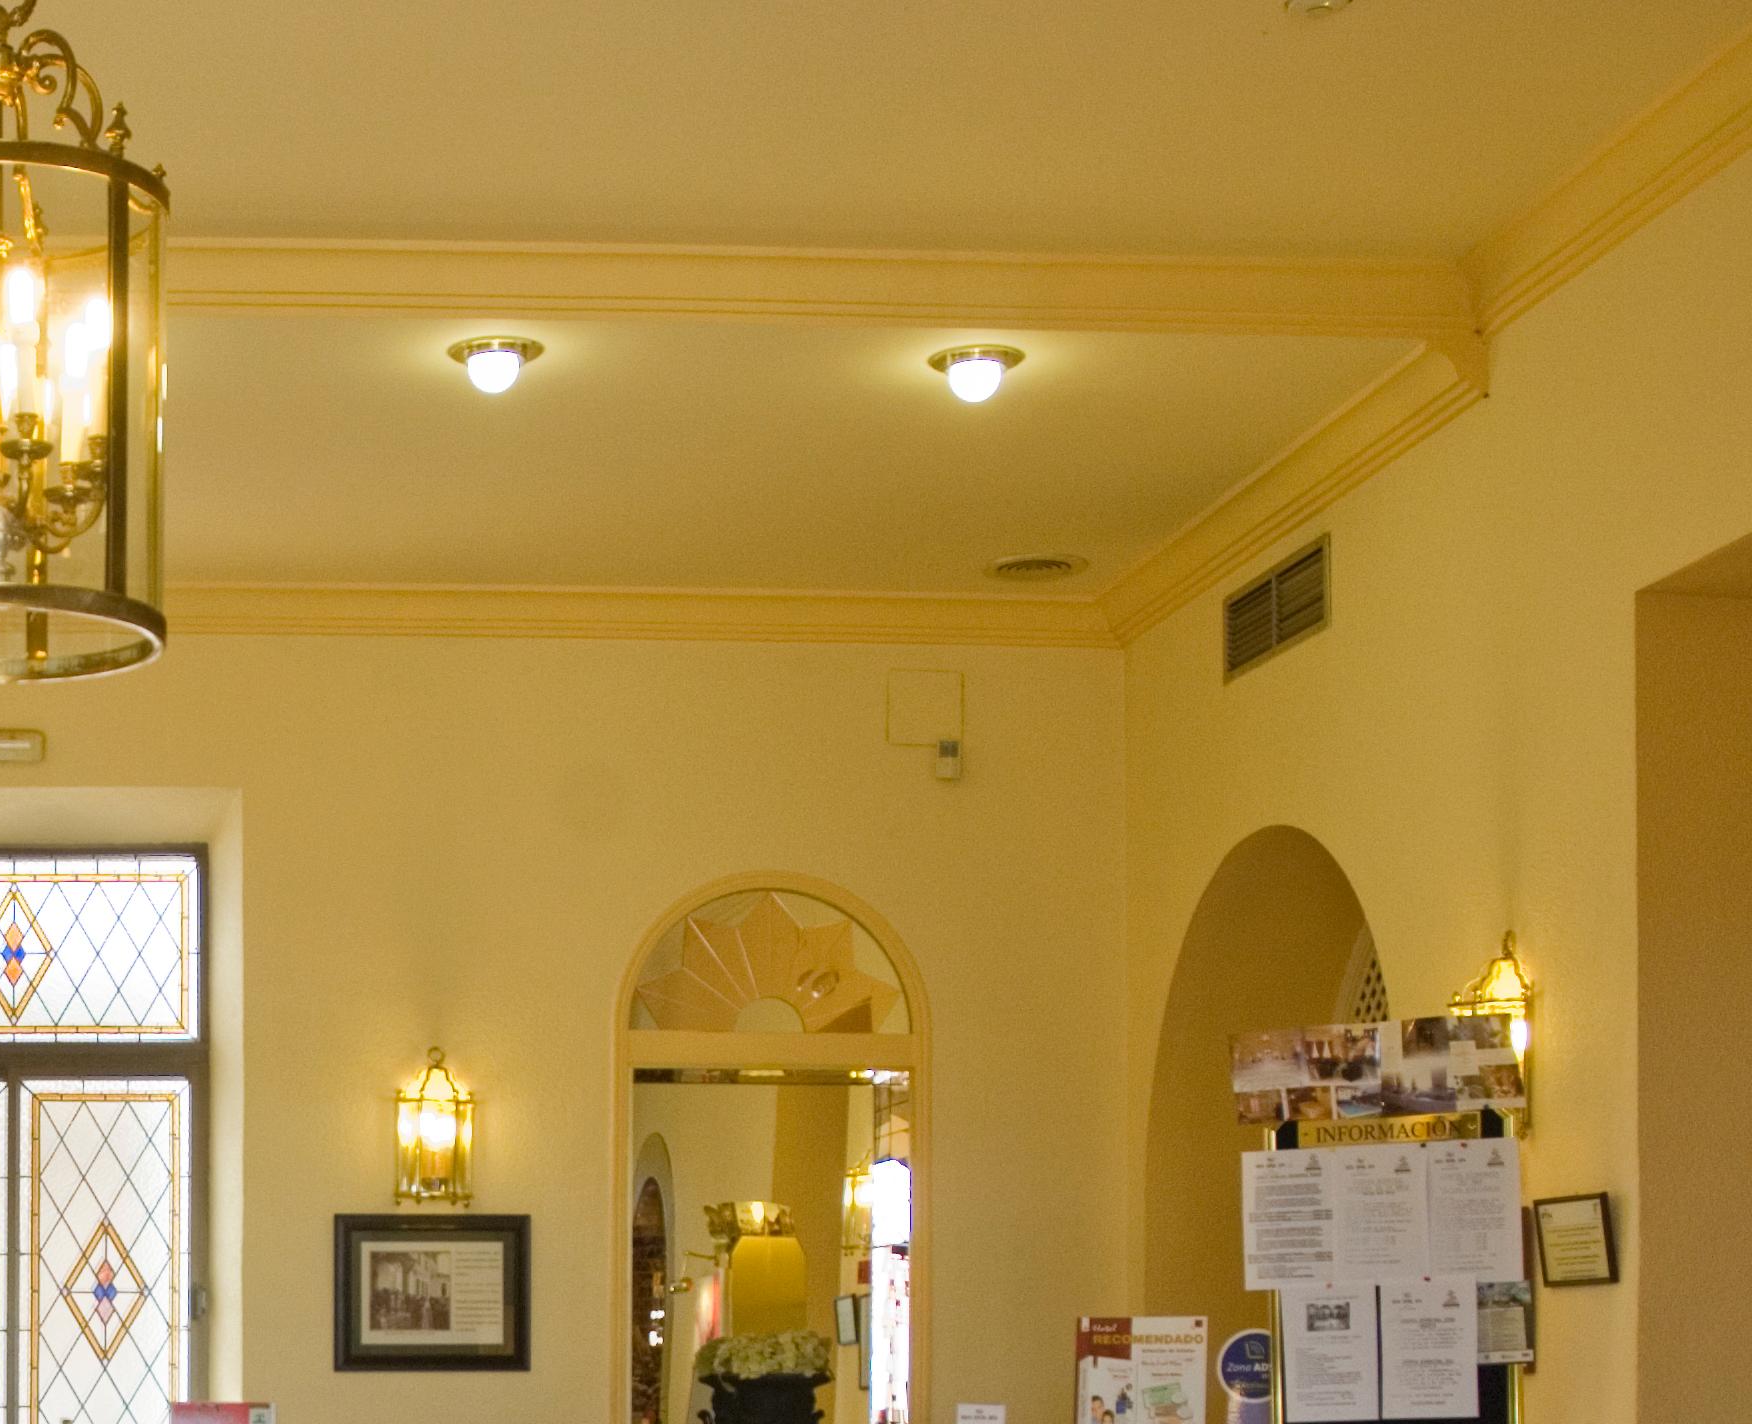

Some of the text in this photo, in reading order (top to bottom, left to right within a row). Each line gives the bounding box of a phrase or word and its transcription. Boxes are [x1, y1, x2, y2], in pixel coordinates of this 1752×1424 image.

[1315, 1120, 1461, 1143] INFORMACIÓN
[1093, 1334, 1204, 1345] RECOMENDADO
[1226, 1362, 1251, 1373] Zona
